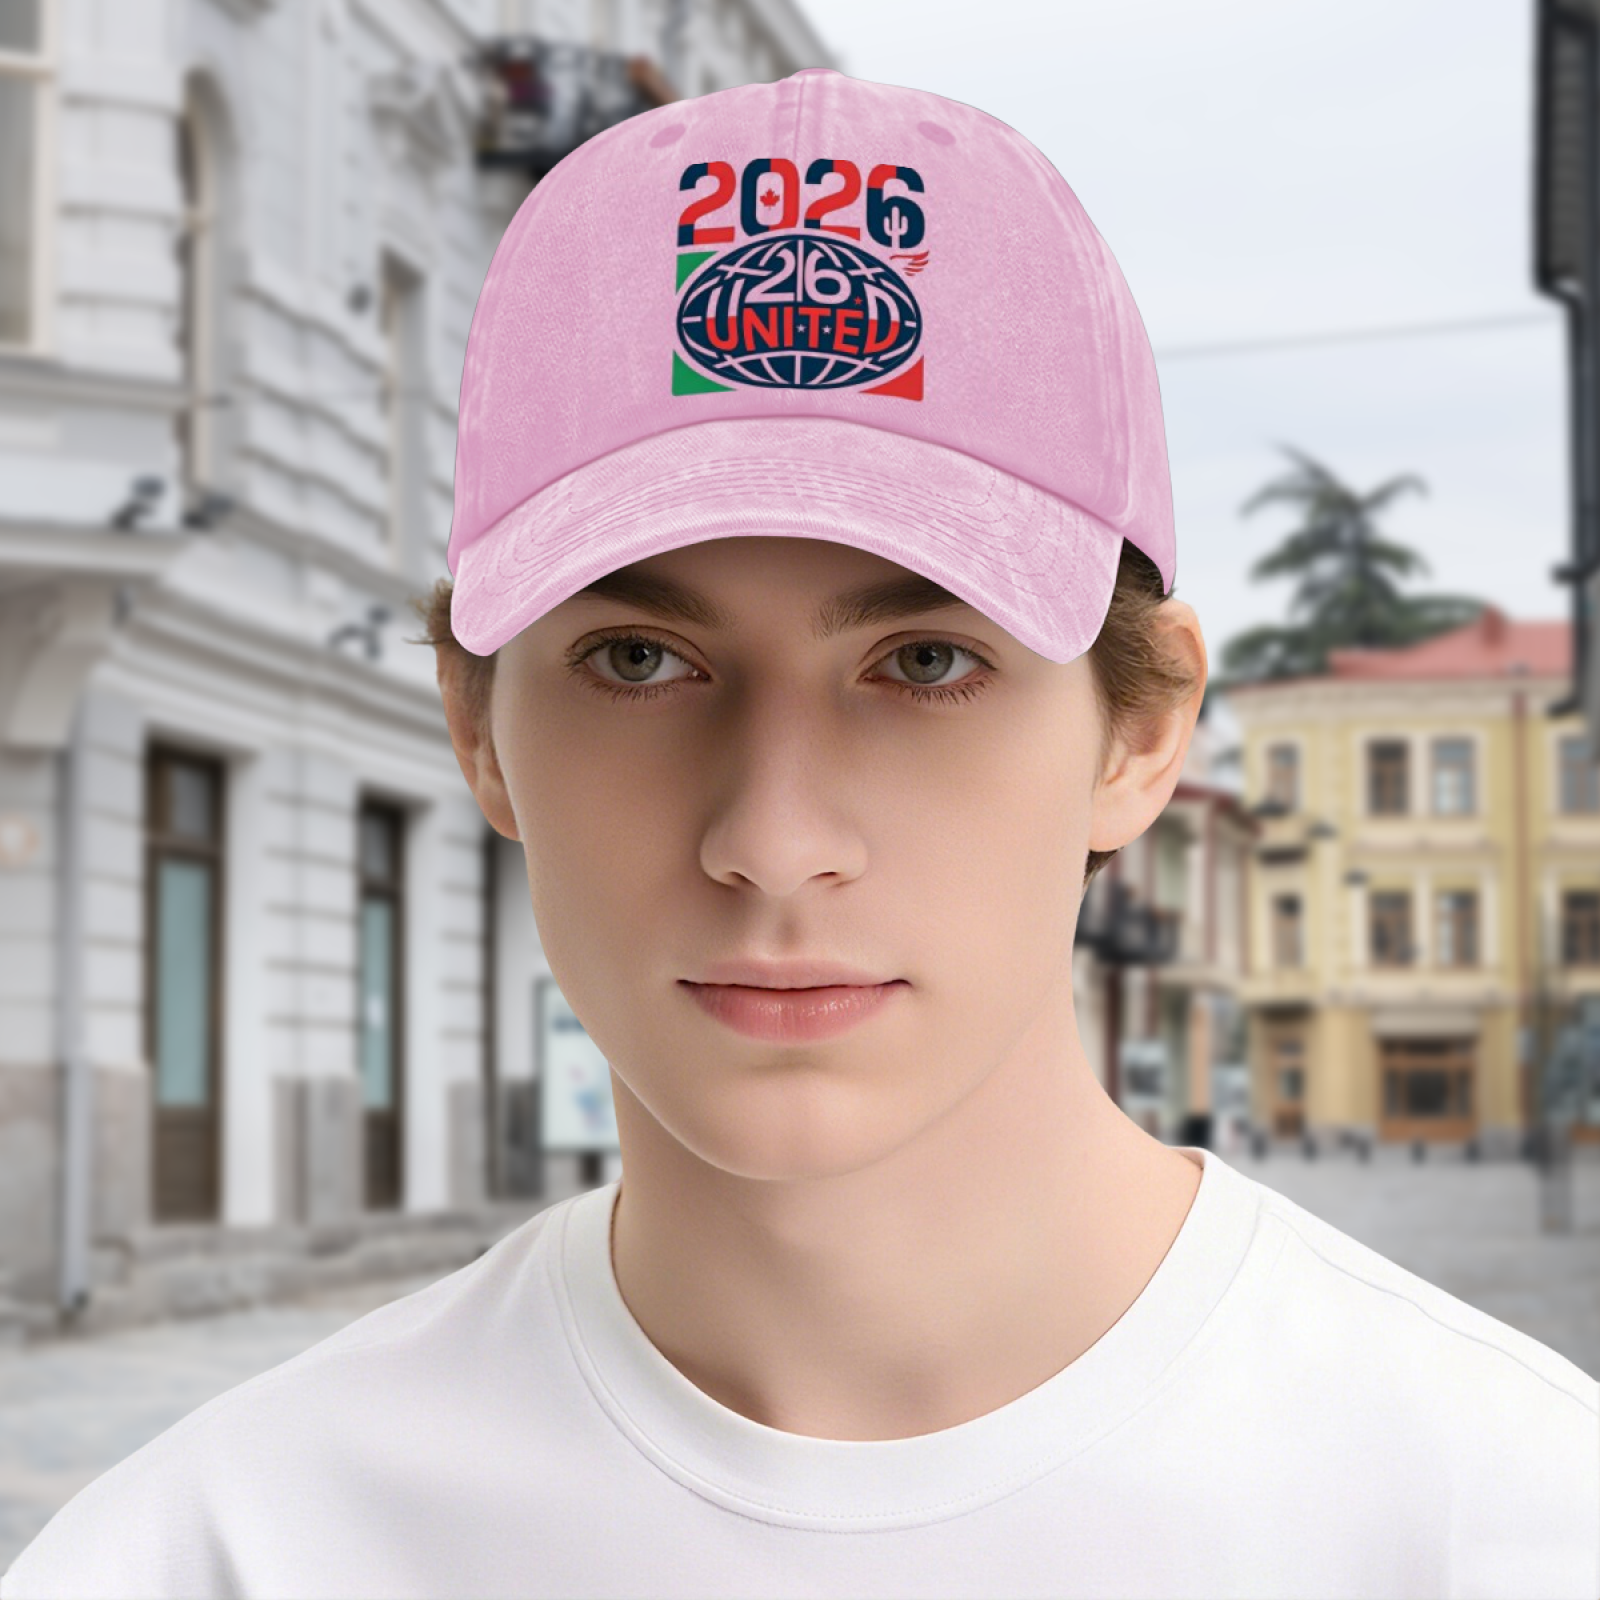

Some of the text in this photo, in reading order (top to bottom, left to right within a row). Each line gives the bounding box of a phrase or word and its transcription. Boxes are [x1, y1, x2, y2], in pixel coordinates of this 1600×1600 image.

[677, 158, 925, 248] 2026
[744, 248, 852, 304] 26
[706, 277, 900, 355] UNITED
